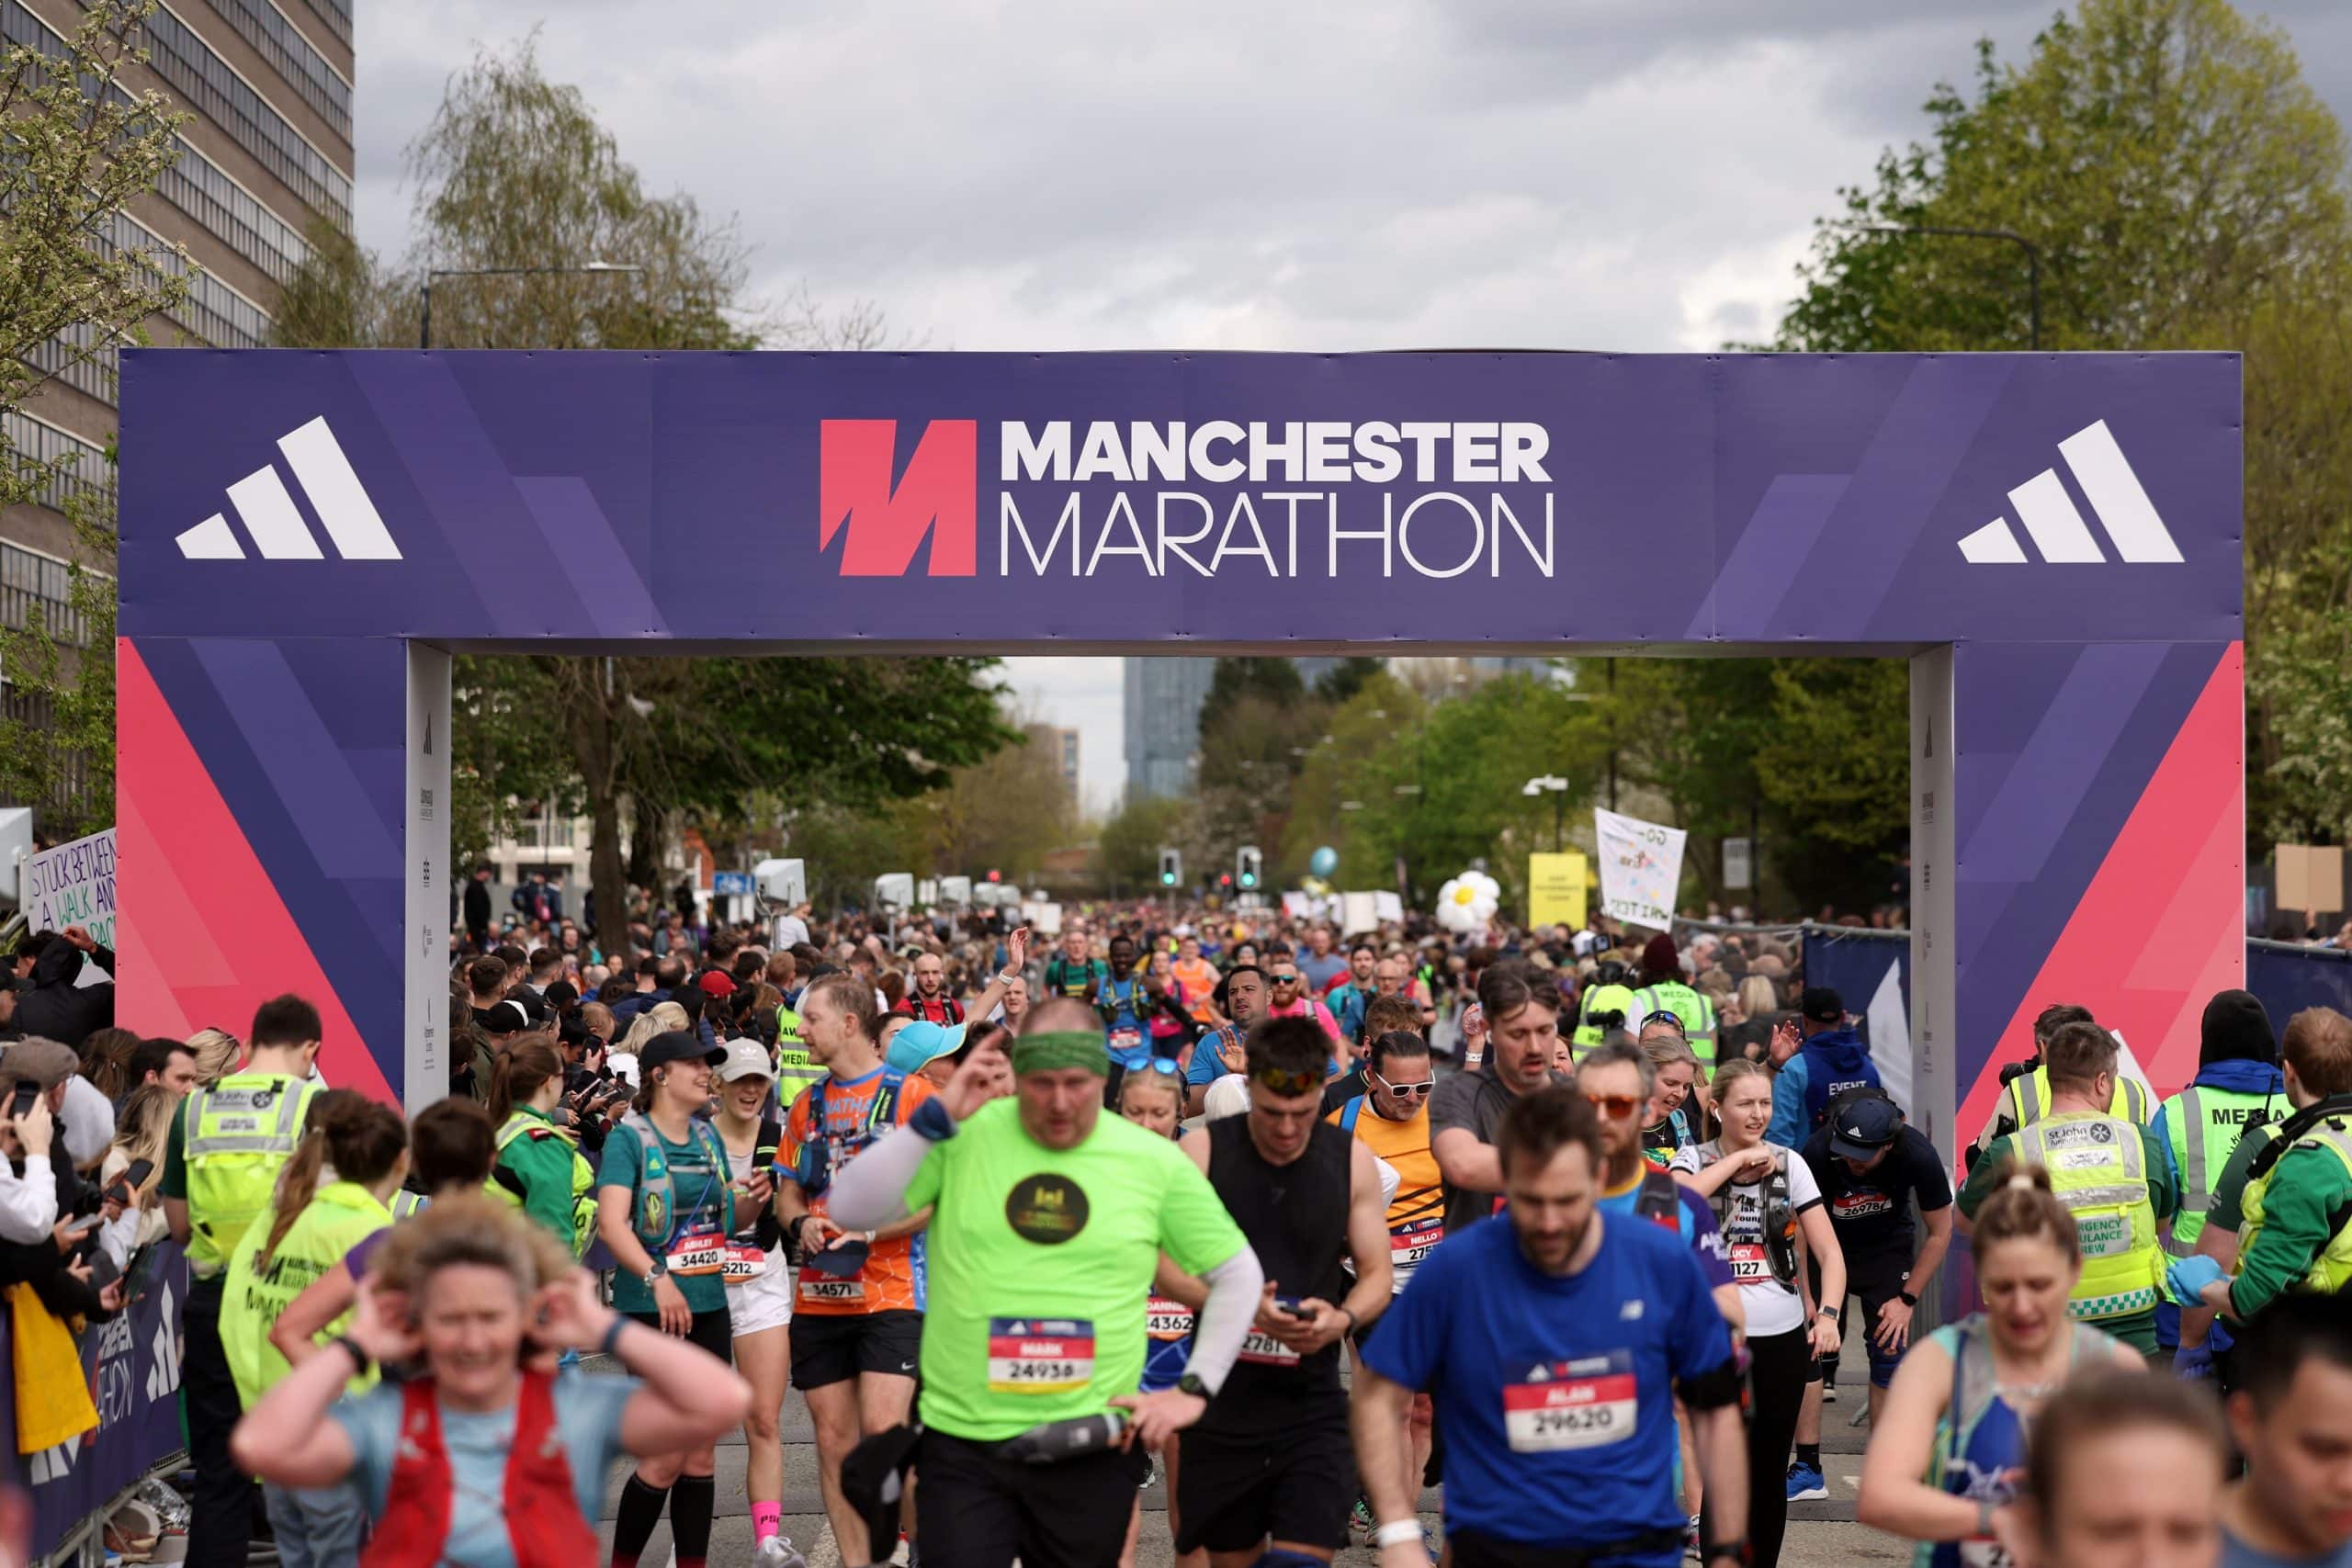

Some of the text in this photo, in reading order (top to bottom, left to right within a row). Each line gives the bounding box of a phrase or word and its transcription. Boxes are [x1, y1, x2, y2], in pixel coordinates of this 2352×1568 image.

[1000, 421, 1555, 483] MANCHESTER
[1000, 491, 1555, 579] MARATHON
[32, 852, 73, 897] STUCK
[42, 901, 55, 931] A
[55, 886, 93, 927] WALK
[89, 914, 116, 952] PAC
[2078, 1218, 2122, 1232] RGENCY
[1410, 1232, 1438, 1246] NELLO
[2079, 1230, 2123, 1244] ULANCE
[1732, 1248, 1752, 1258] UCY
[2080, 1244, 2105, 1255] REW
[681, 1250, 718, 1268] 34420
[721, 1262, 752, 1275] 5212
[1731, 1261, 1759, 1276] 127
[1148, 1316, 1193, 1330] 4362
[1242, 1335, 1280, 1353] 2781
